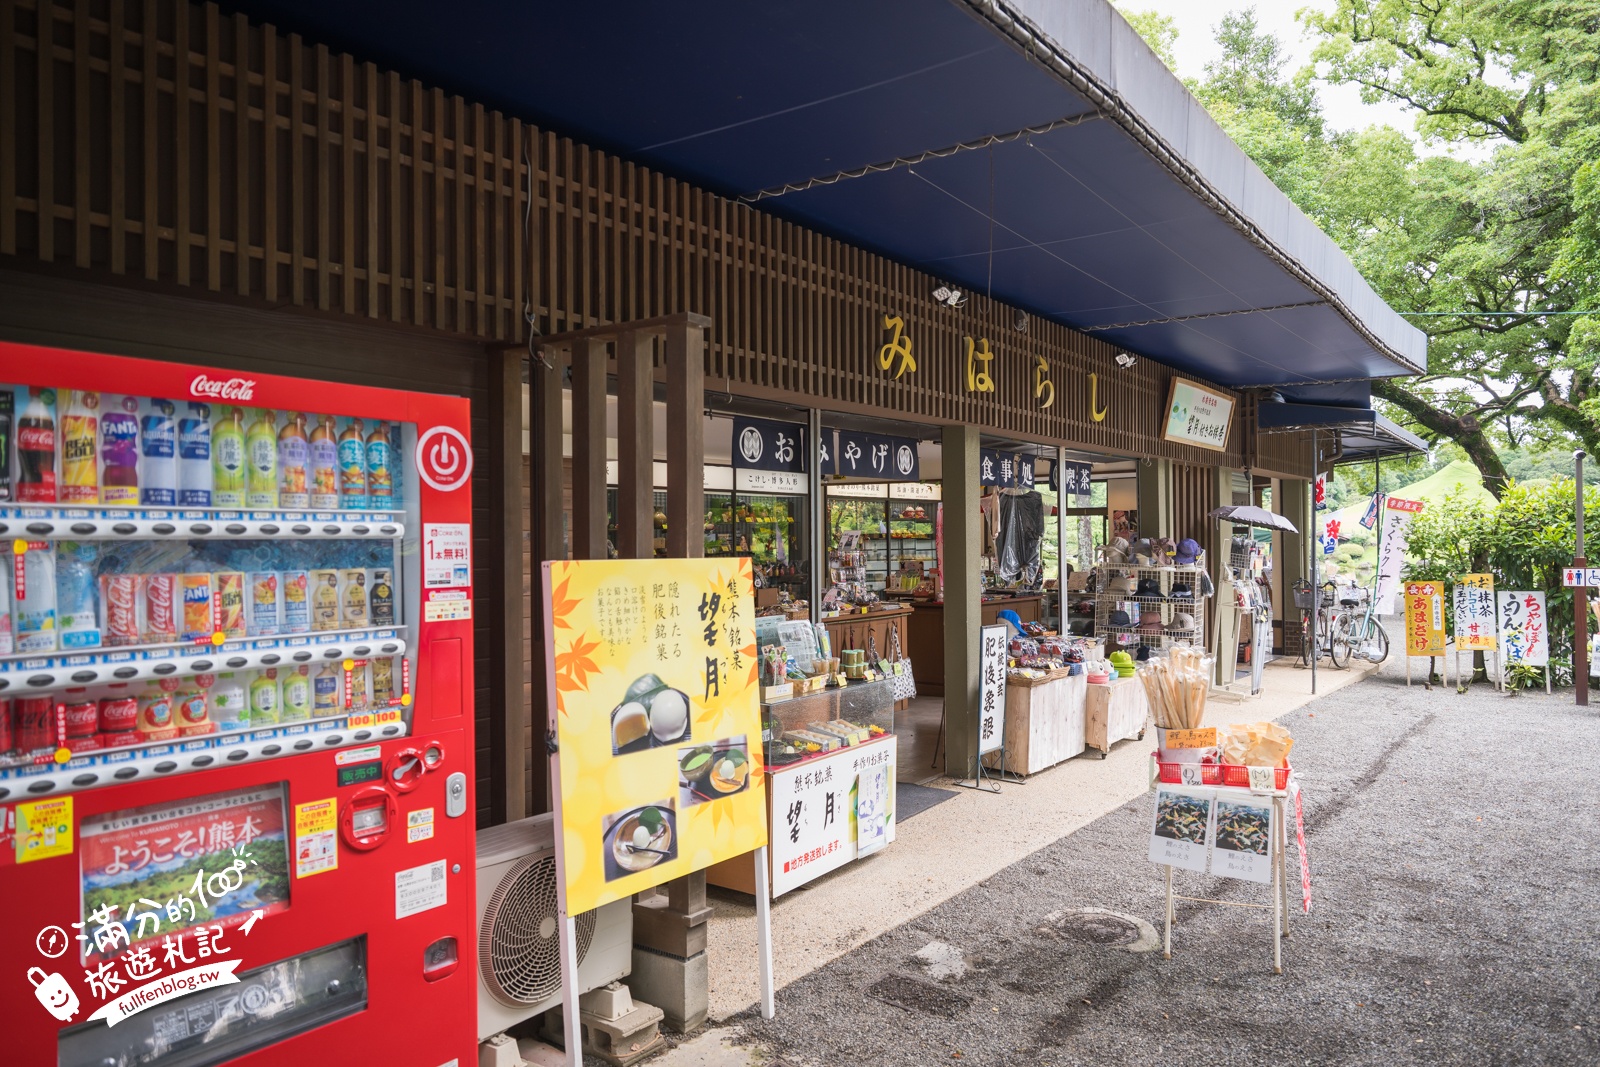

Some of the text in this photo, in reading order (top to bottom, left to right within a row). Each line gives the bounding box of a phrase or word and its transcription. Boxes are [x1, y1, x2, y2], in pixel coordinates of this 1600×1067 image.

[190, 375, 256, 400] Coca-Cola
[877, 314, 1107, 422] みはらし
[981, 455, 1033, 485] 食事処
[427, 540, 468, 560] 1本無料!
[652, 583, 669, 661] 肥後銘菓
[668, 583, 682, 658] 隠れたる
[727, 579, 743, 670] 熊本銘菓
[1413, 597, 1430, 651] あまざけ
[1467, 580, 1480, 644] ホットコーヒー 甘酒
[698, 592, 721, 703] 望月
[342, 766, 378, 782] 販売中
[794, 765, 833, 793] 熊本銘菓
[853, 750, 890, 771] 手作りお菓子
[105, 815, 263, 875] ようこそ!熊本
[790, 839, 842, 871] 地方発送致します。
